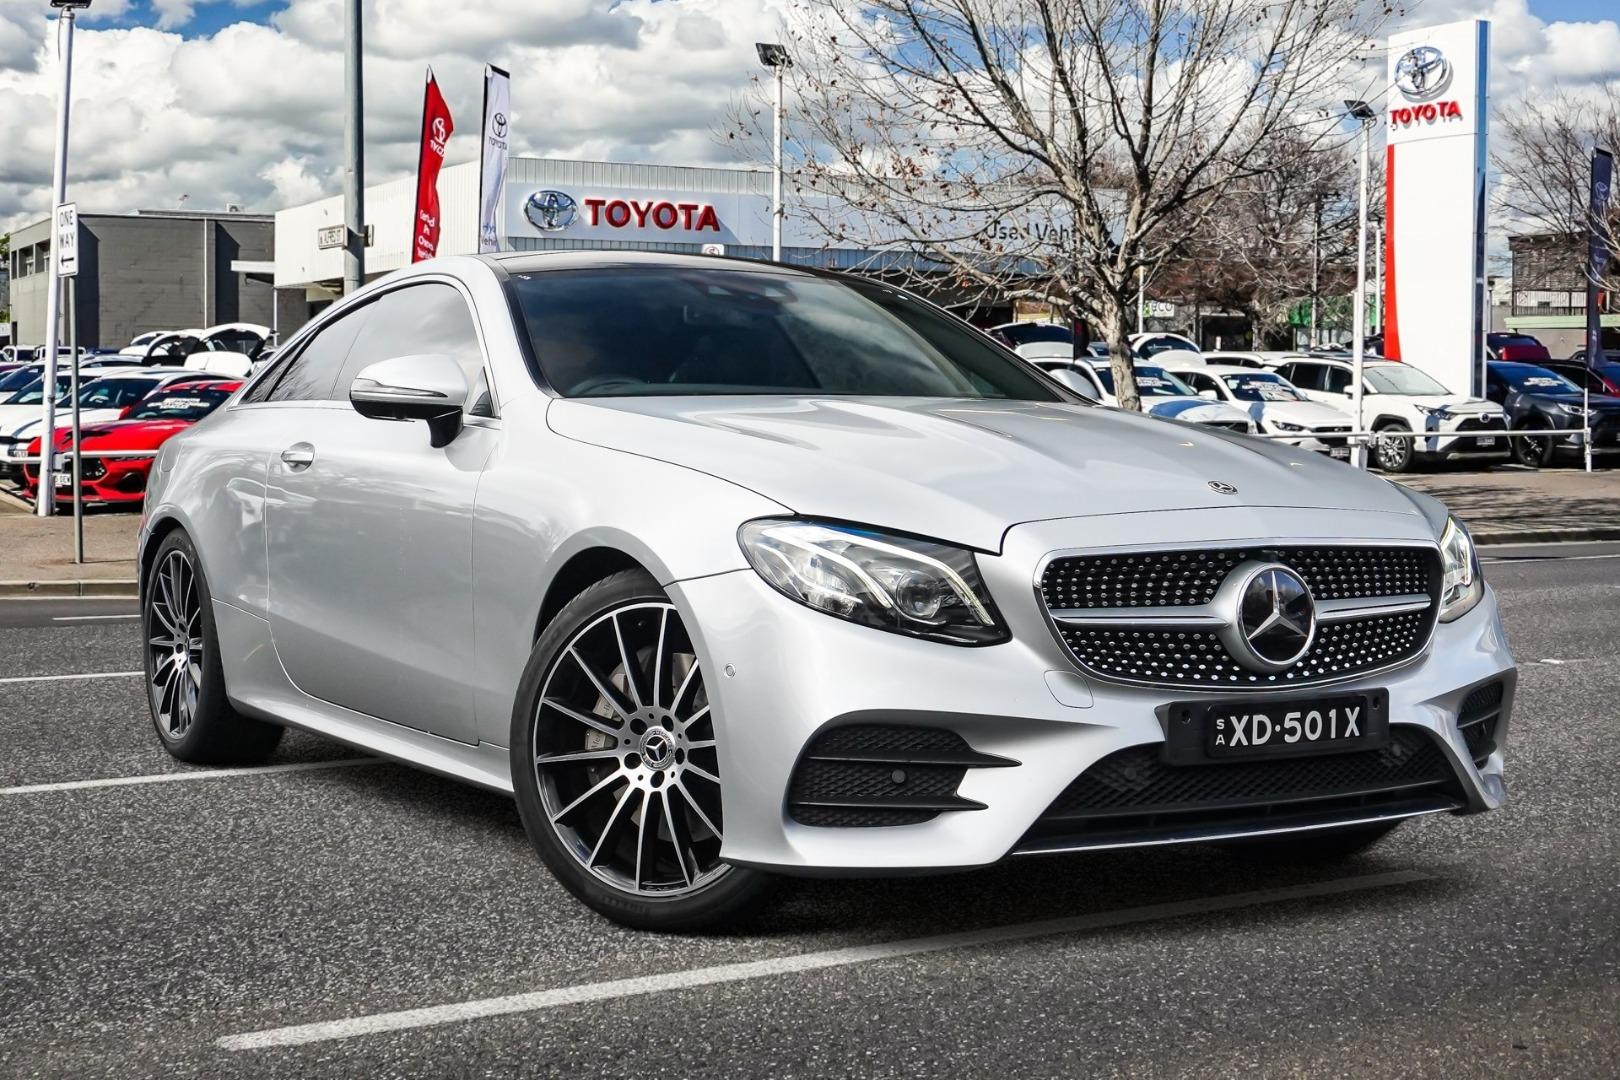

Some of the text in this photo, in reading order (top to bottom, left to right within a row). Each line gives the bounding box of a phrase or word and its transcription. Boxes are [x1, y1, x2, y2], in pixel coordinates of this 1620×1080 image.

[1389, 101, 1463, 124] TOYOTA
[60, 210, 74, 228] ONE
[584, 199, 721, 232] TOYOTA
[59, 232, 75, 248] WAY
